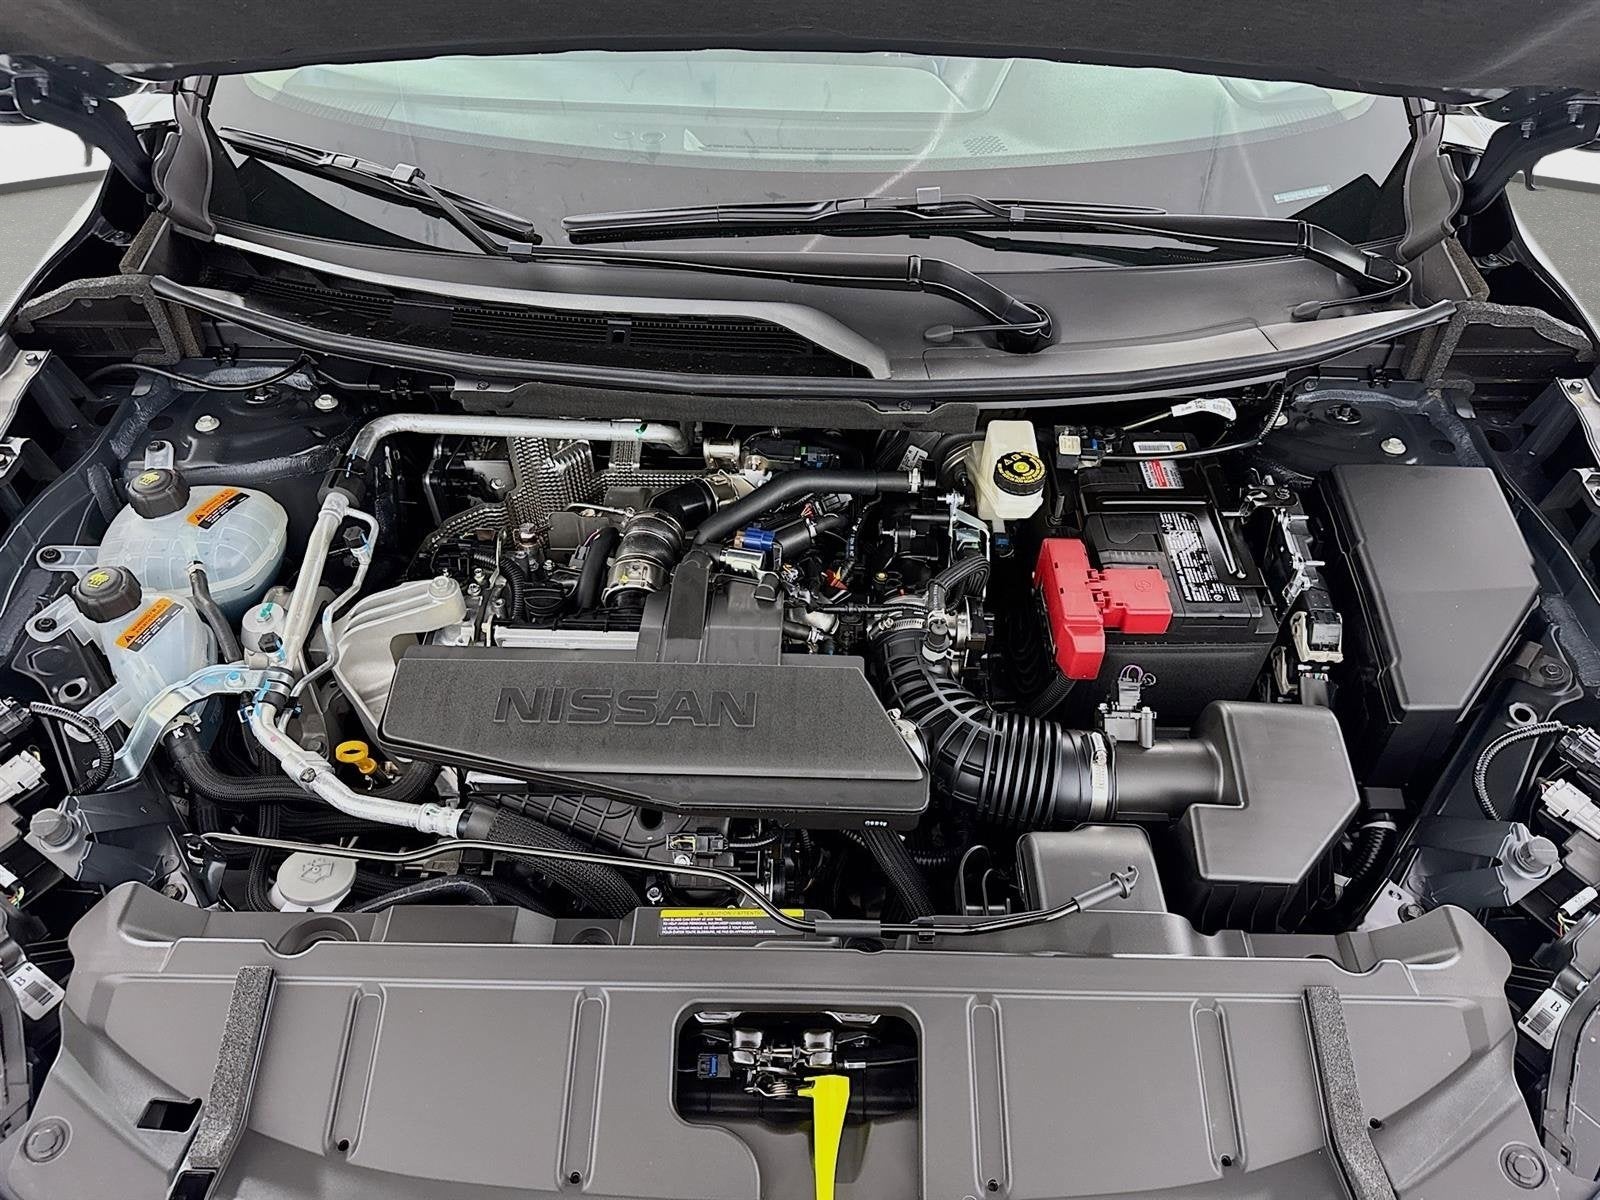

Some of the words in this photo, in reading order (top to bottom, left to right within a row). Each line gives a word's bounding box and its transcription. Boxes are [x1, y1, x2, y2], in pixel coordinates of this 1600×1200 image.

[493, 686, 757, 728] NISSAN
[13, 976, 26, 986] B
[1550, 1001, 1561, 1011] B
